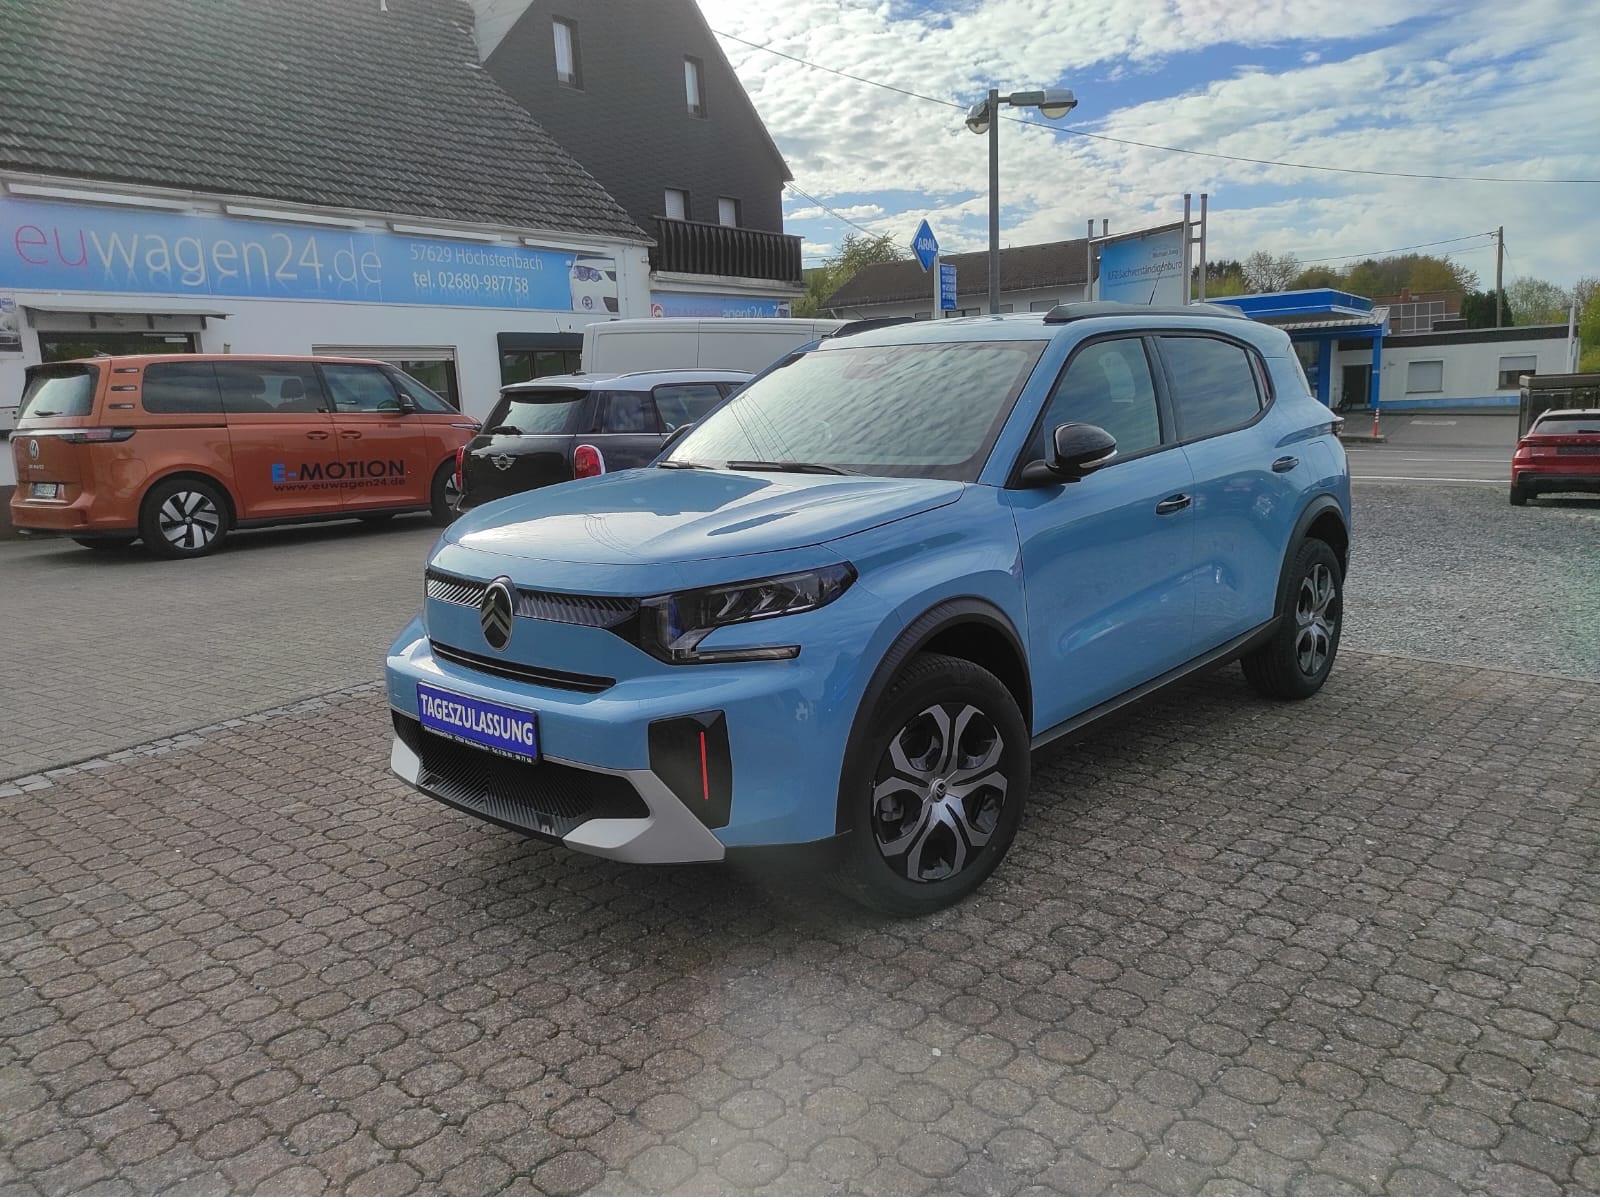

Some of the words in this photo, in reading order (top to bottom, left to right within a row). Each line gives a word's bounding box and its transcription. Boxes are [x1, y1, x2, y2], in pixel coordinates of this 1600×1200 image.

[15, 224, 382, 286] euwagen24.de
[410, 243, 452, 263] 57629
[455, 247, 543, 271] Höchstenbach
[412, 270, 436, 288] tel.
[438, 271, 529, 294] 02680-987758
[271, 459, 405, 484] E-MOTION
[273, 478, 406, 492] www.euwagen24.de
[420, 693, 534, 746] TAGESZULASSUNG
